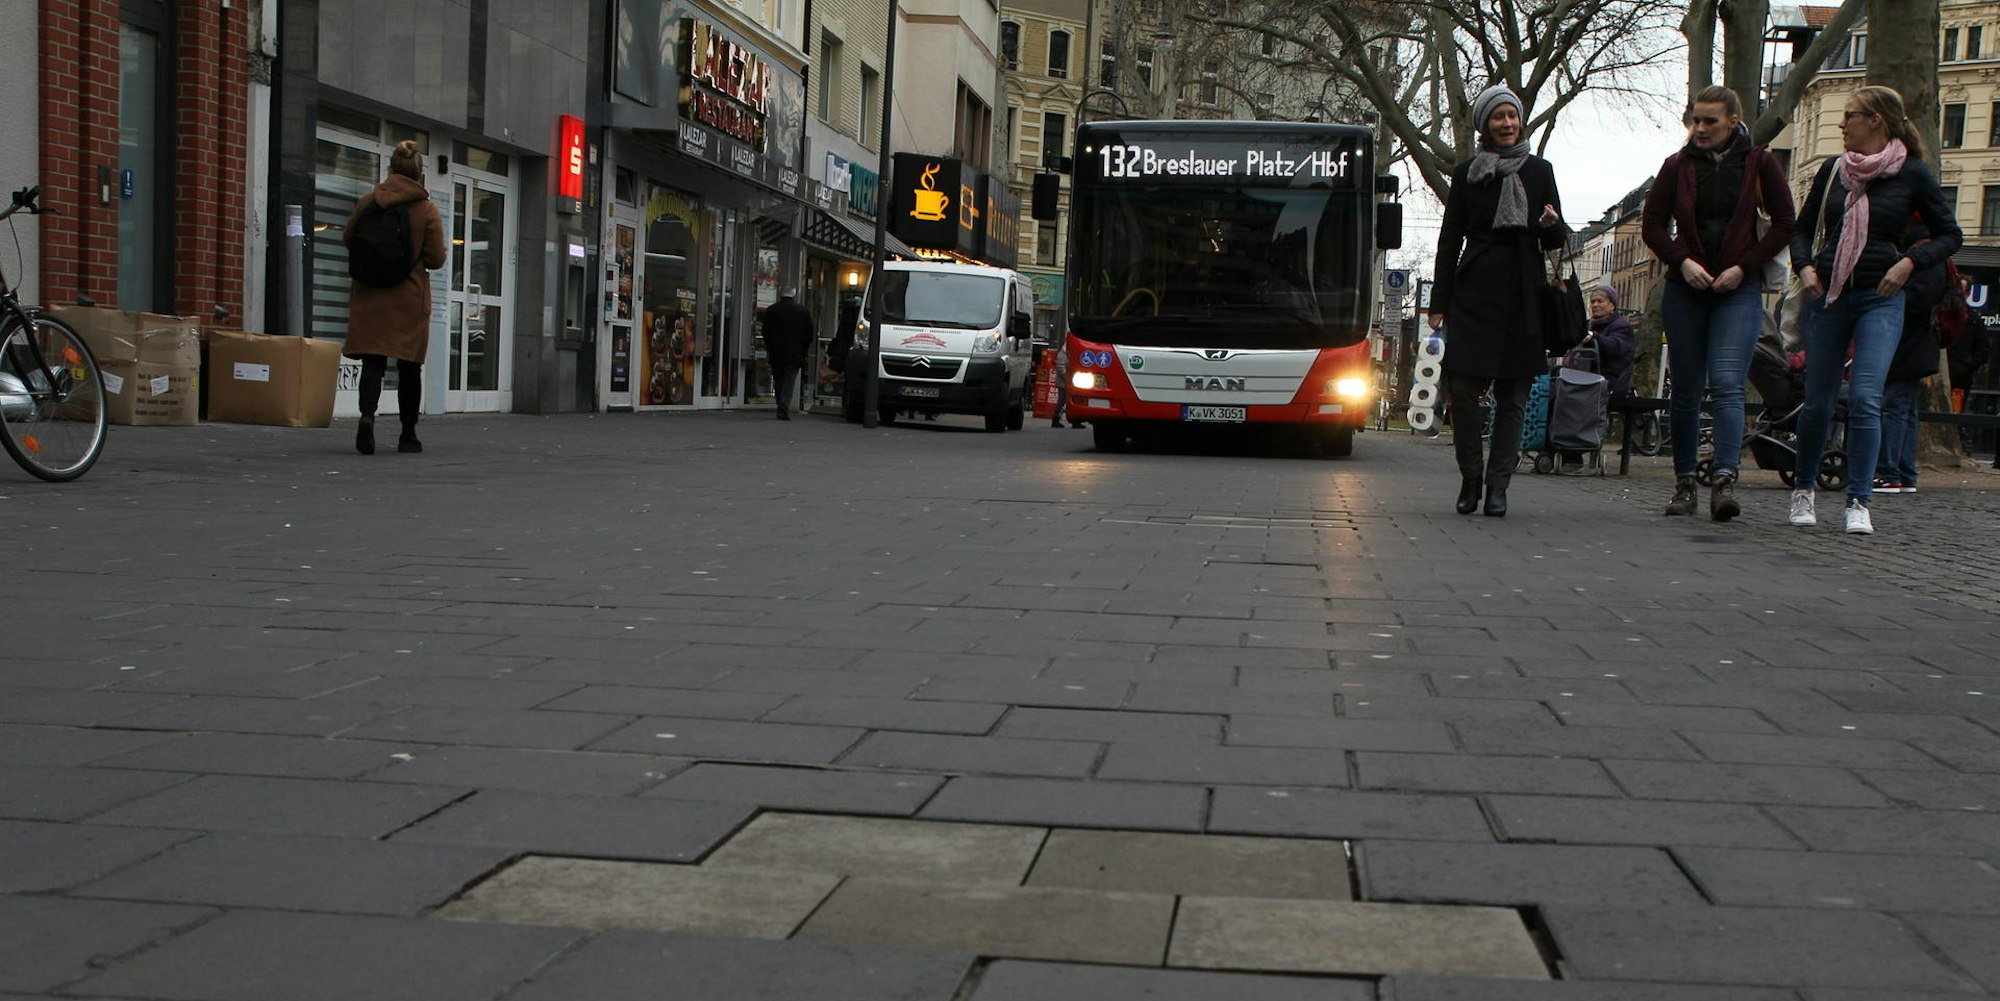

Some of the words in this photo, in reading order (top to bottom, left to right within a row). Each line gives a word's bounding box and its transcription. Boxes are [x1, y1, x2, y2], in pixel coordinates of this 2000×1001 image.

[691, 19, 771, 117] LALEZAR
[683, 122, 707, 148] LALEZAR
[733, 146, 755, 168] LALEZAR
[1100, 145, 1141, 177] 132
[1143, 149, 1238, 176] Breslauer
[1246, 150, 1349, 177] Platz/Hbf
[781, 167, 799, 188] LALEZAR
[817, 184, 832, 202] LALEZAR
[1966, 285, 1989, 307] U
[1185, 376, 1246, 391] MAN
[1190, 408, 1196, 419] K
[1203, 408, 1217, 419] VK
[1219, 408, 1244, 420] 3051
